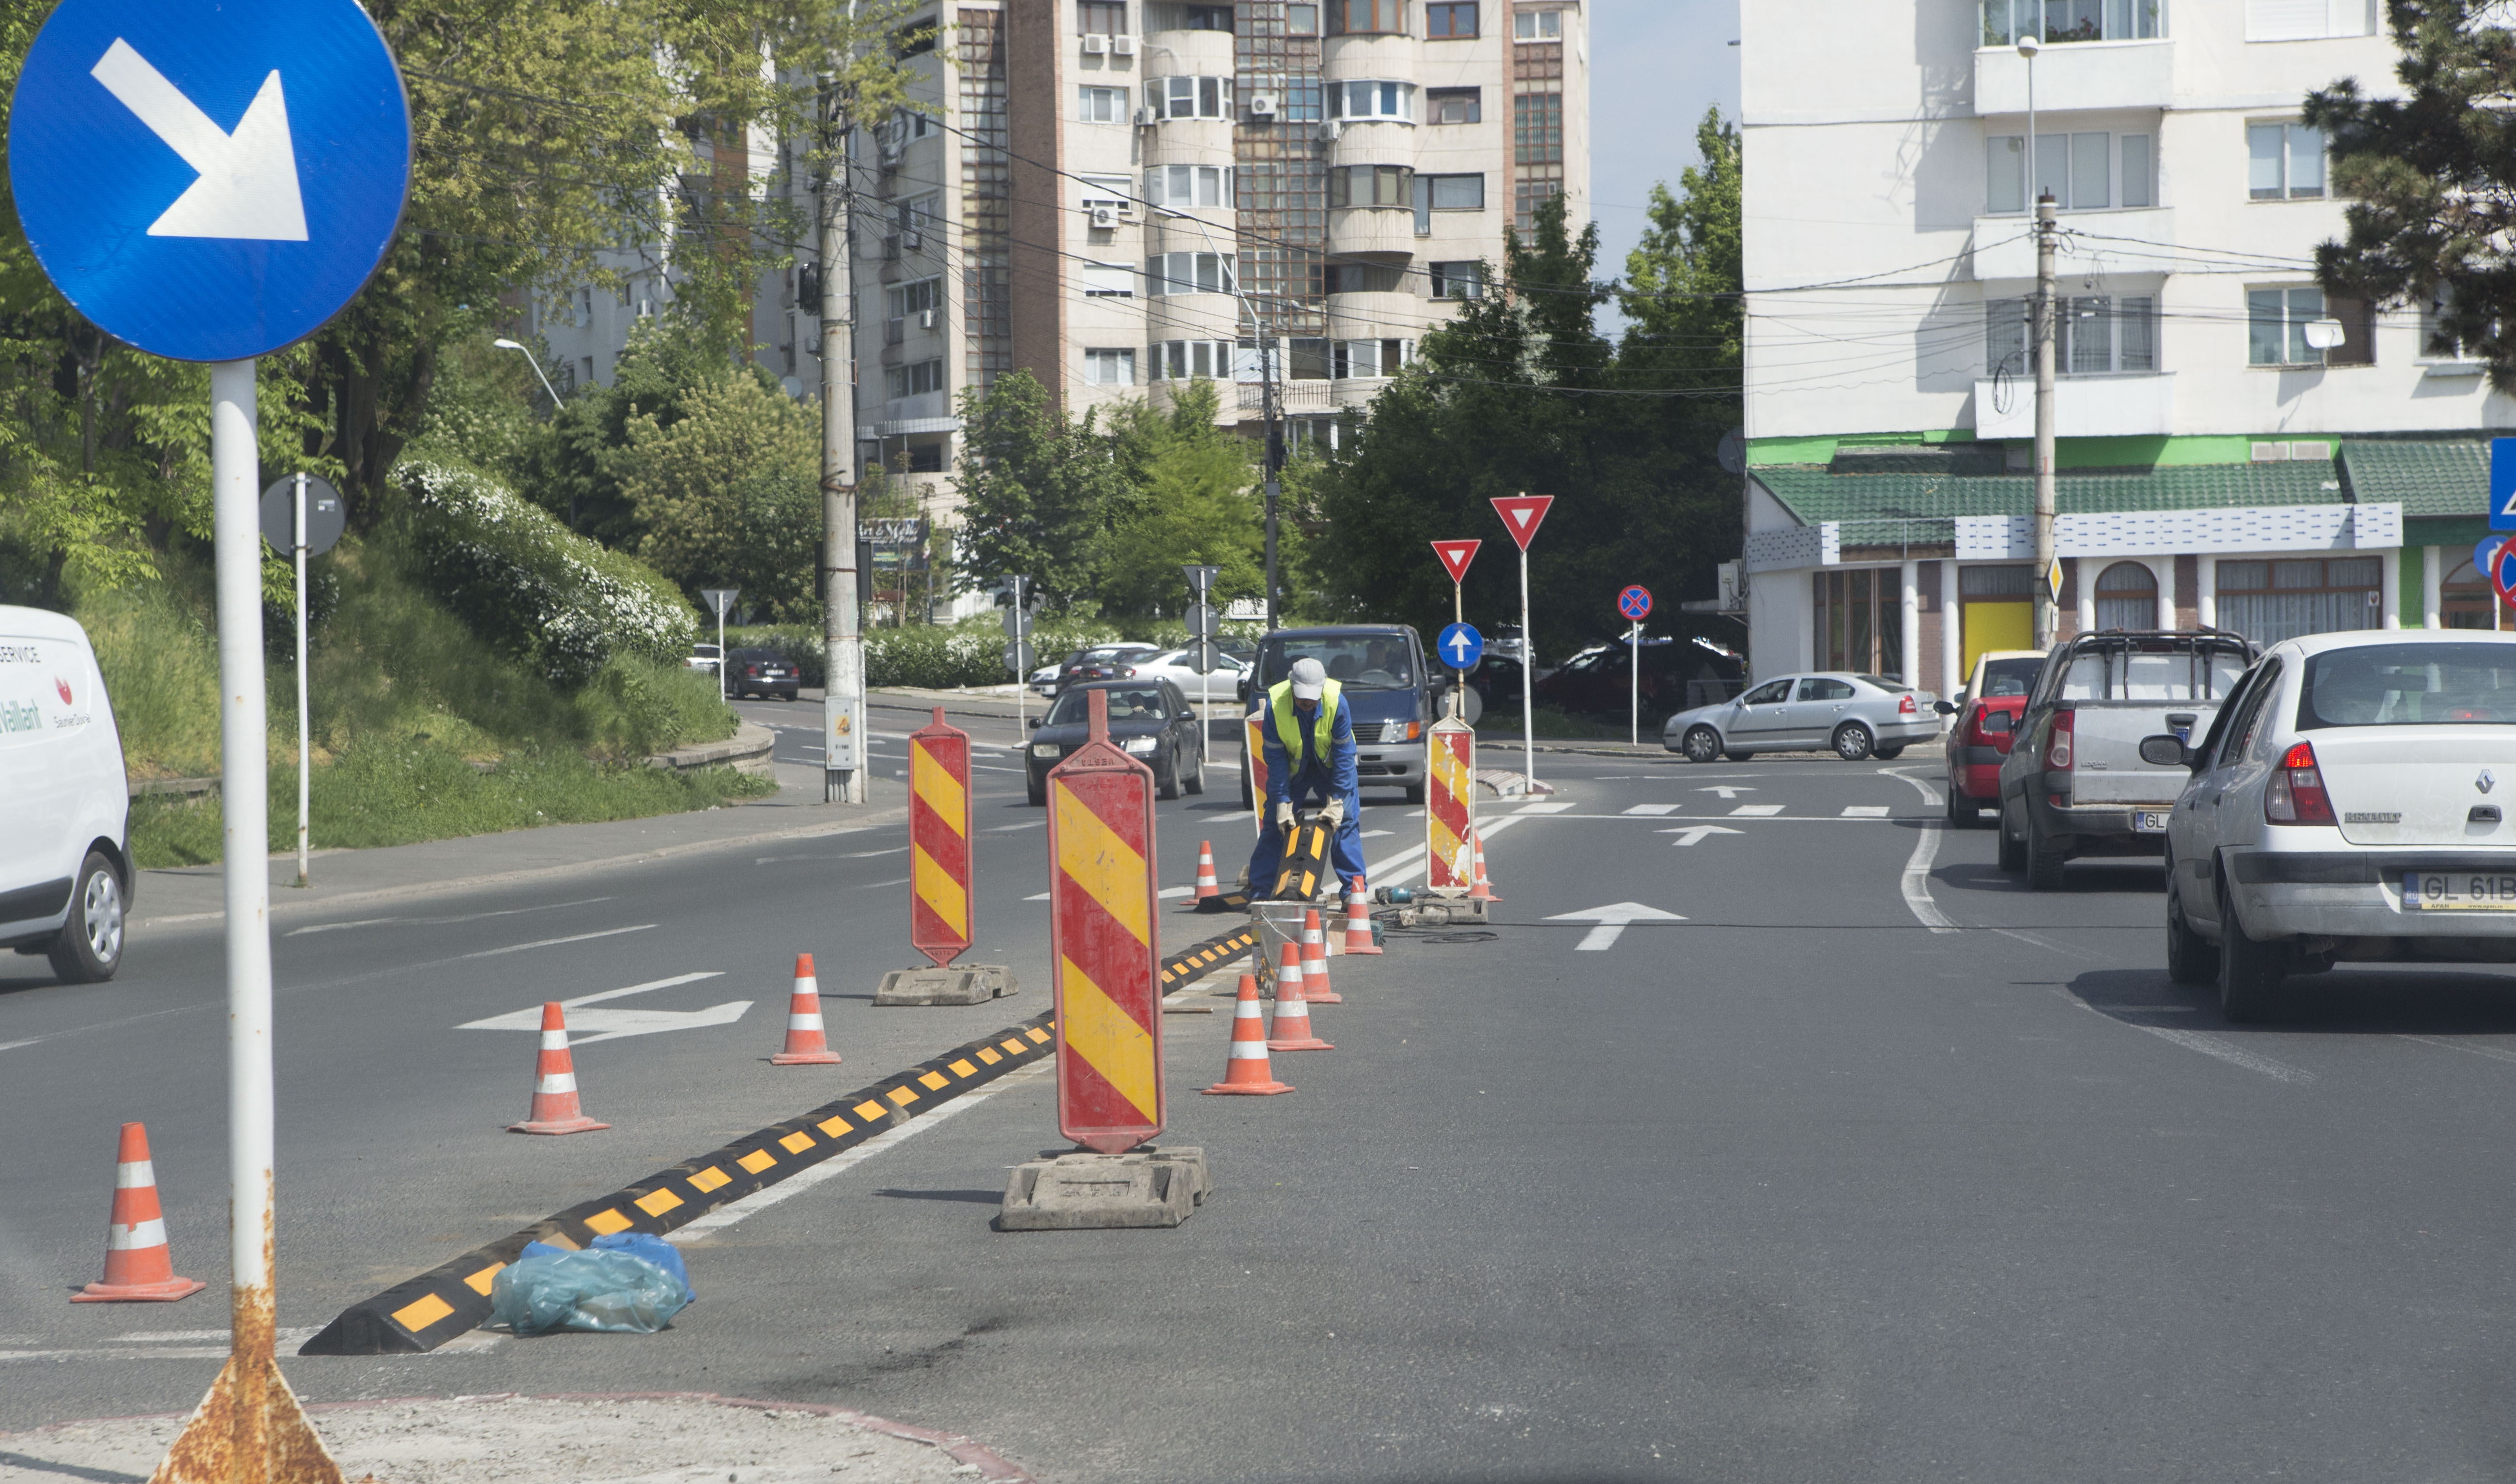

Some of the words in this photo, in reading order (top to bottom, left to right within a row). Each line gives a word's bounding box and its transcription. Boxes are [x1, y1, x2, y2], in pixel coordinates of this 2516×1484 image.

[2146, 814, 2164, 828] GL
[2406, 890, 2418, 900] RO
[2424, 876, 2459, 901] GL
[2470, 876, 2516, 901] 61B
